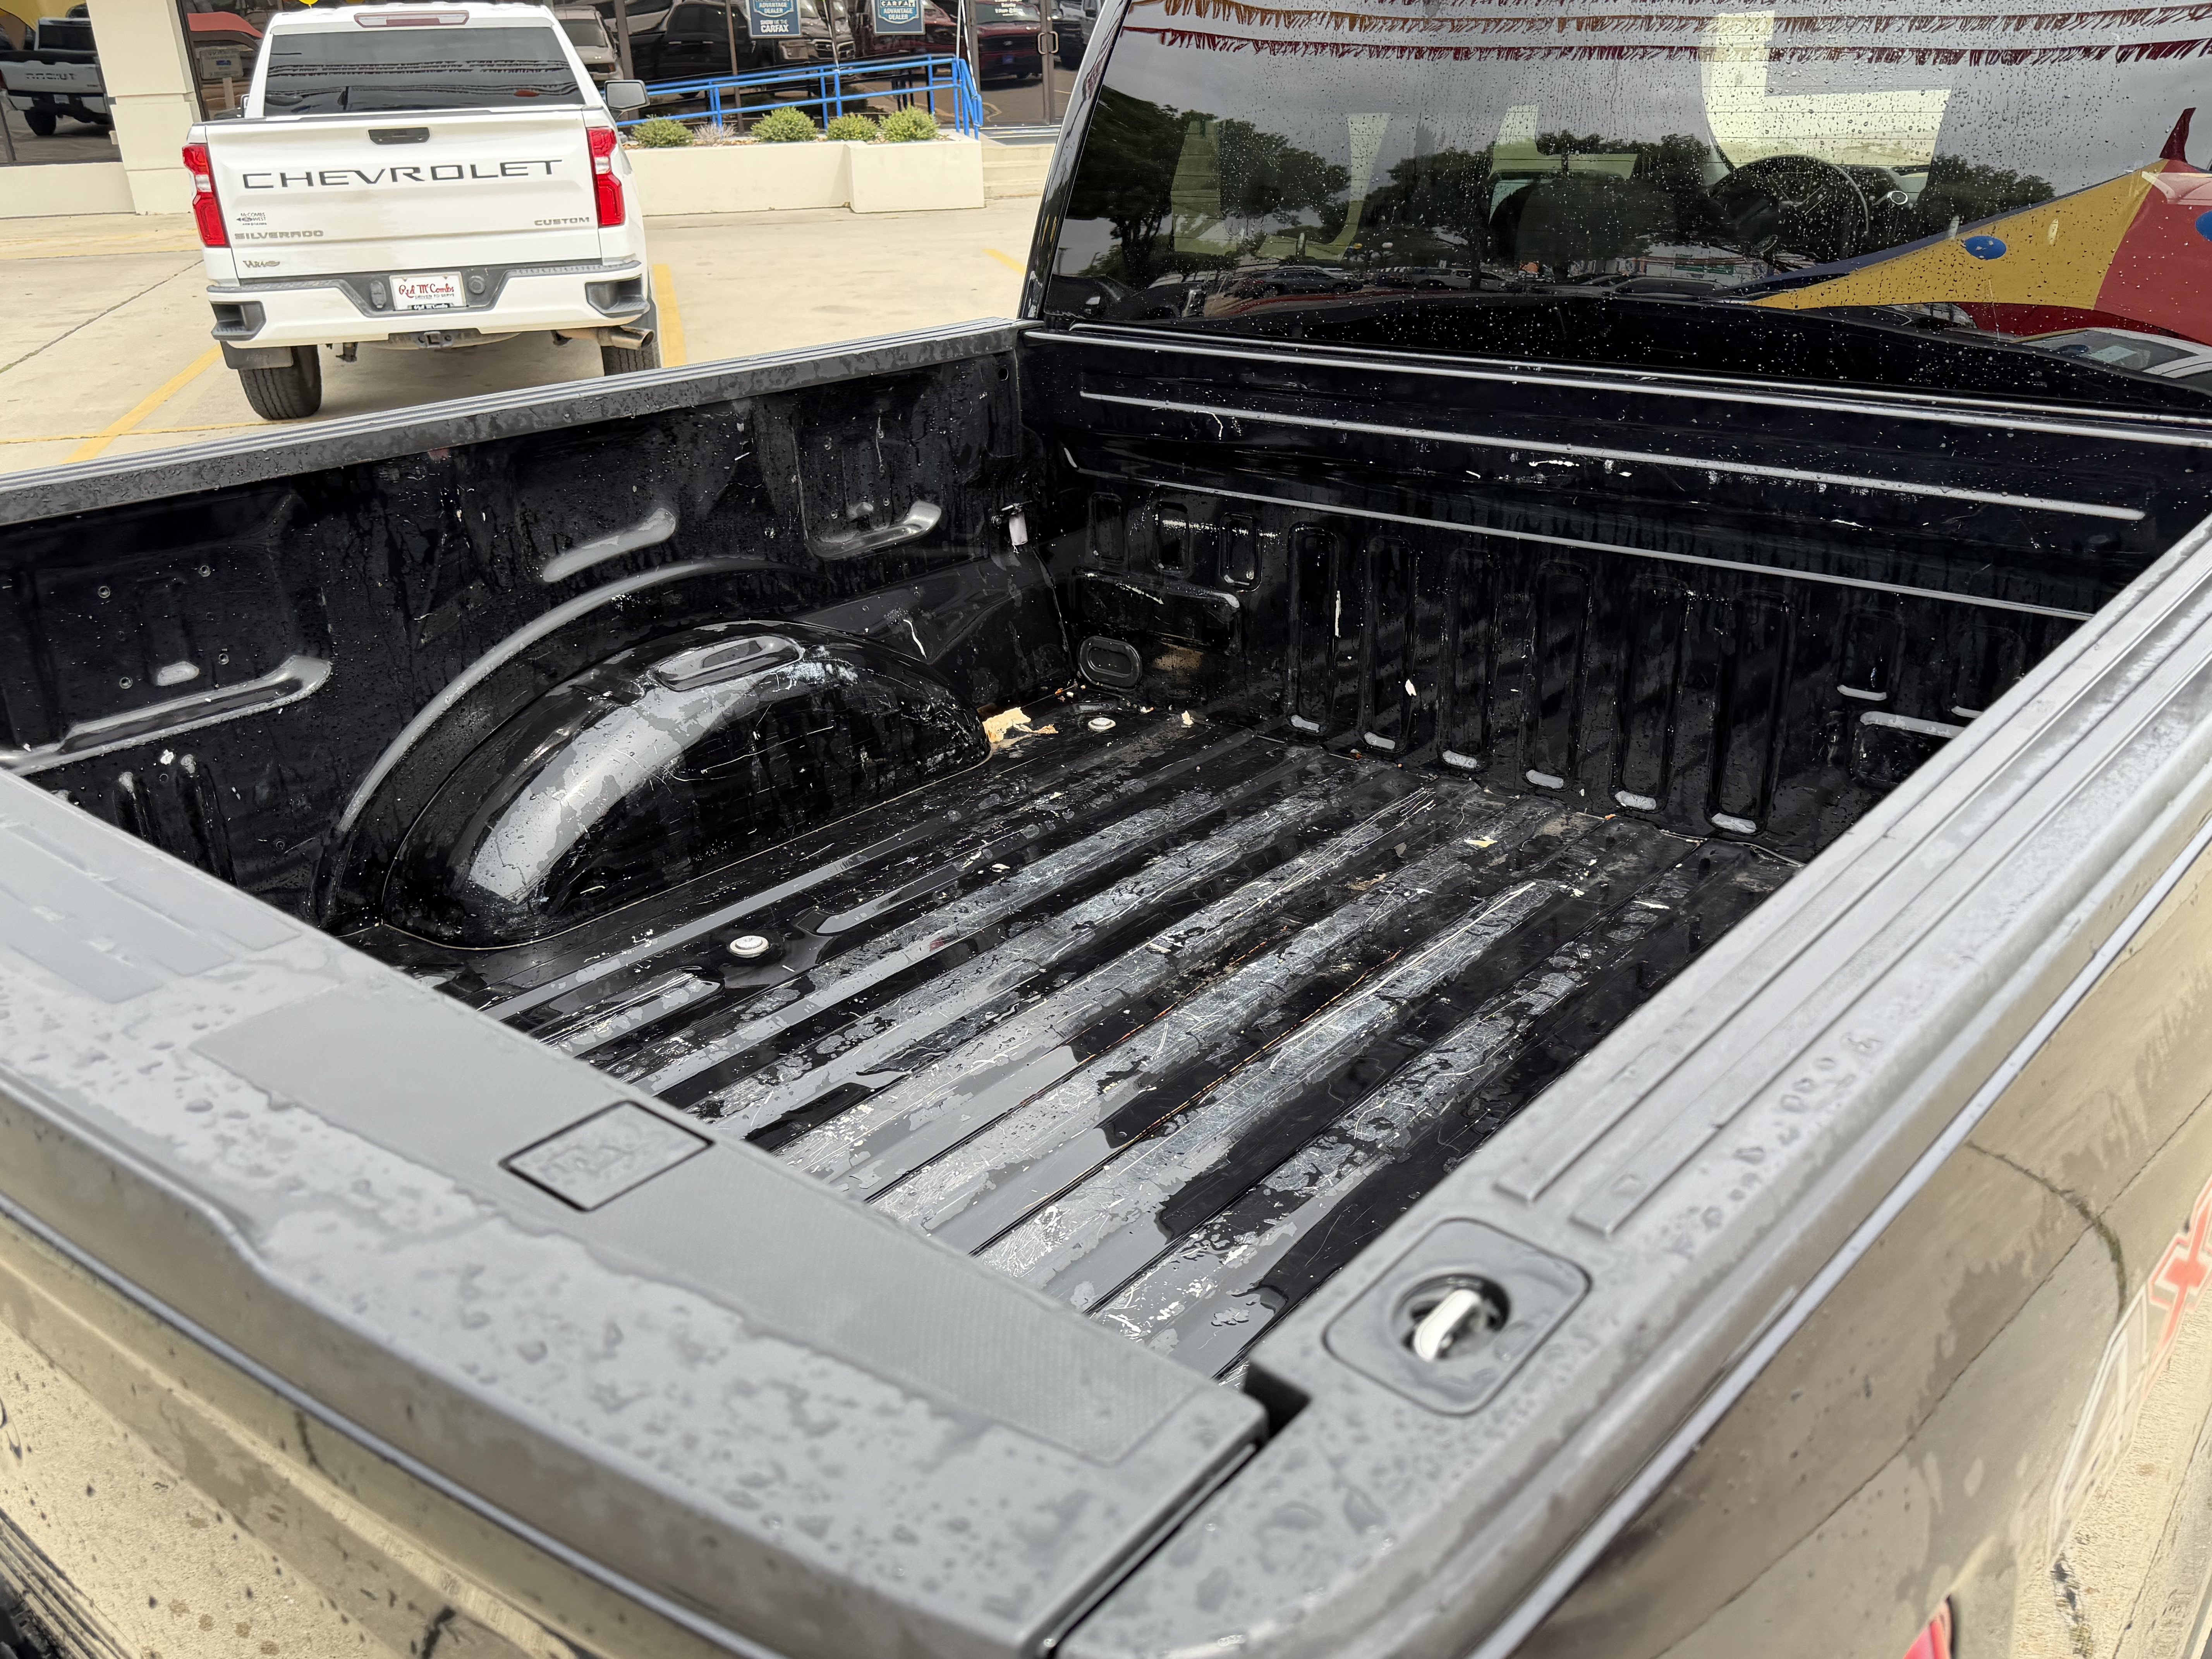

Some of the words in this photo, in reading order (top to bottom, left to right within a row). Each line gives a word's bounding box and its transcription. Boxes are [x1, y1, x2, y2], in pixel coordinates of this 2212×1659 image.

[761, 24, 789, 33] CARFAX
[242, 159, 563, 189] CHEVROLET
[534, 217, 590, 226] CUSTOM
[235, 230, 324, 239] SILVERADO
